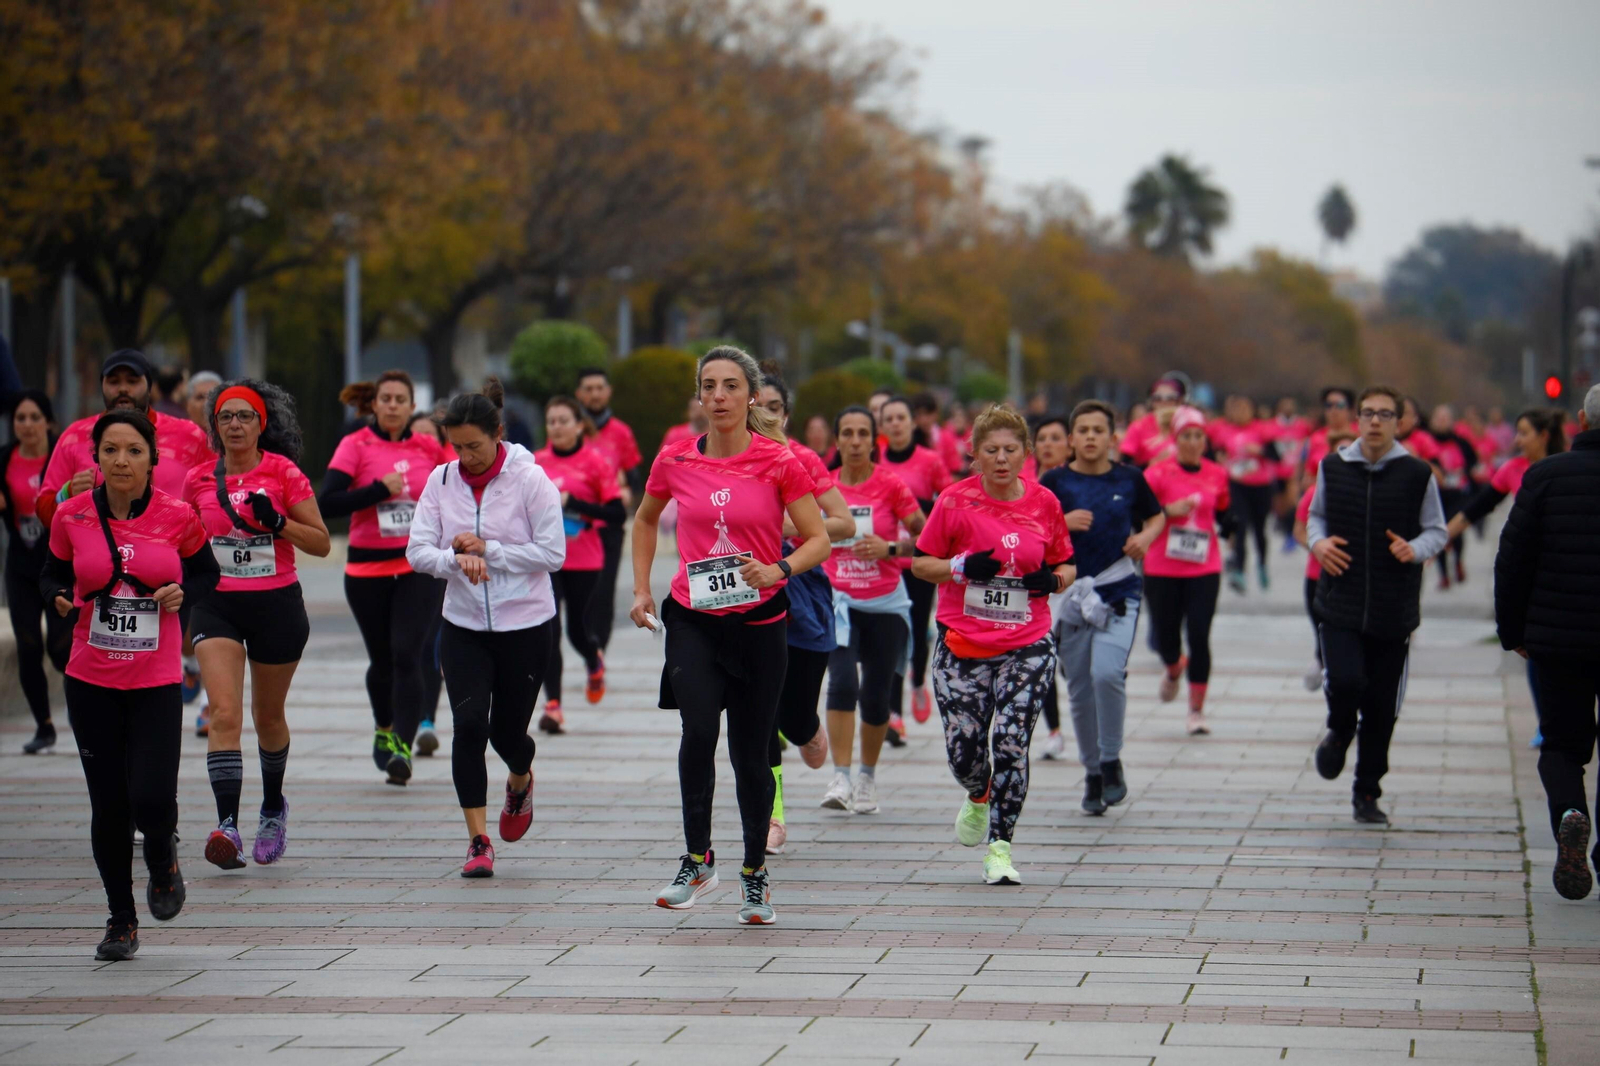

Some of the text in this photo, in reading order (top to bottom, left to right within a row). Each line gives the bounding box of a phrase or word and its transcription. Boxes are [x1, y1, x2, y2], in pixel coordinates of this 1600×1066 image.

[391, 511, 415, 524] 133
[233, 550, 252, 564] 64
[836, 560, 878, 571] PINK
[836, 570, 880, 578] RUNNING
[708, 571, 736, 592] 314
[983, 590, 1009, 606] 541
[108, 614, 137, 632] 914
[108, 652, 134, 660] 2023
